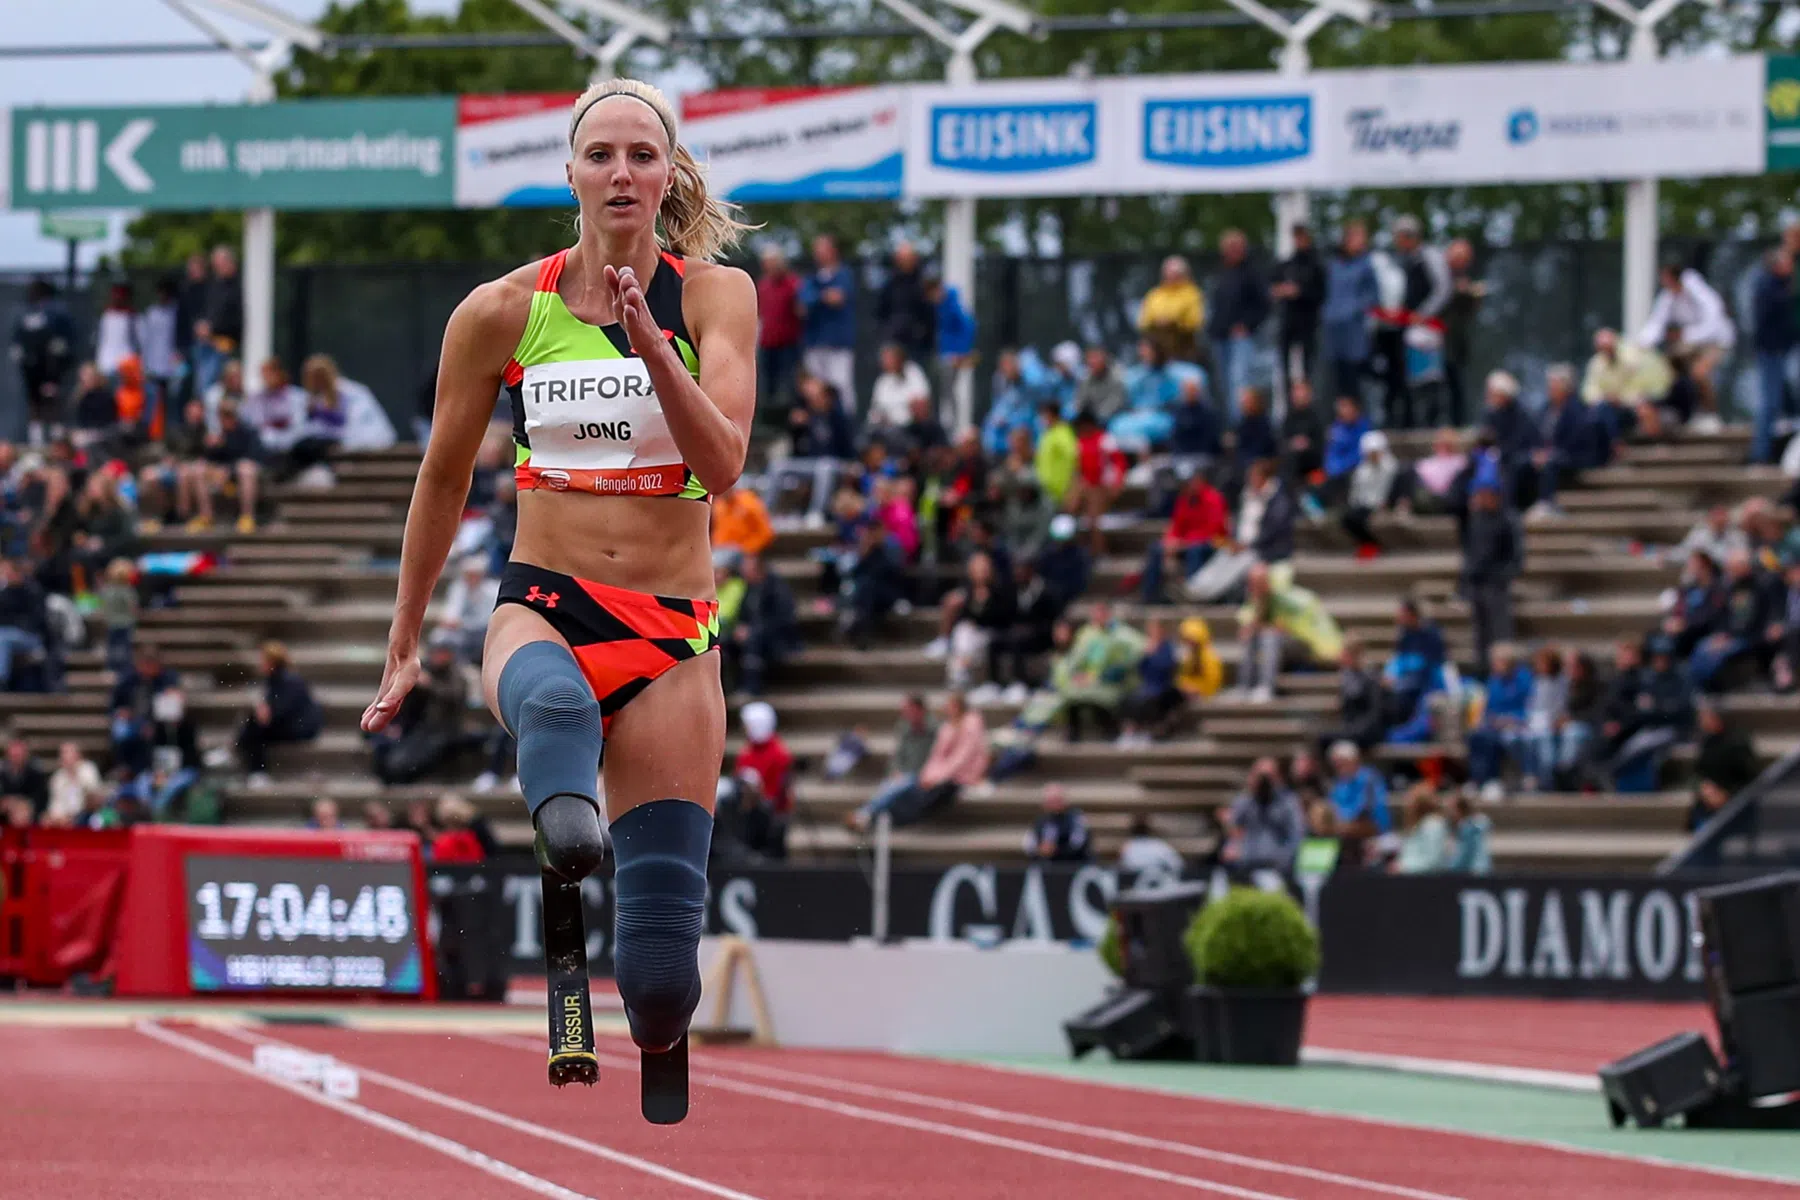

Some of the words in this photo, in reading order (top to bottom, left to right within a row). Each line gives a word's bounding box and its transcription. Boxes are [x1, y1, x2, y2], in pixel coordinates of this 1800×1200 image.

[180, 133, 228, 172] mk
[235, 129, 442, 178] sportmarketing
[573, 421, 632, 441] JONG
[595, 475, 637, 495] Hengelo
[638, 473, 663, 490] 2022
[196, 881, 409, 943] 17:04:48
